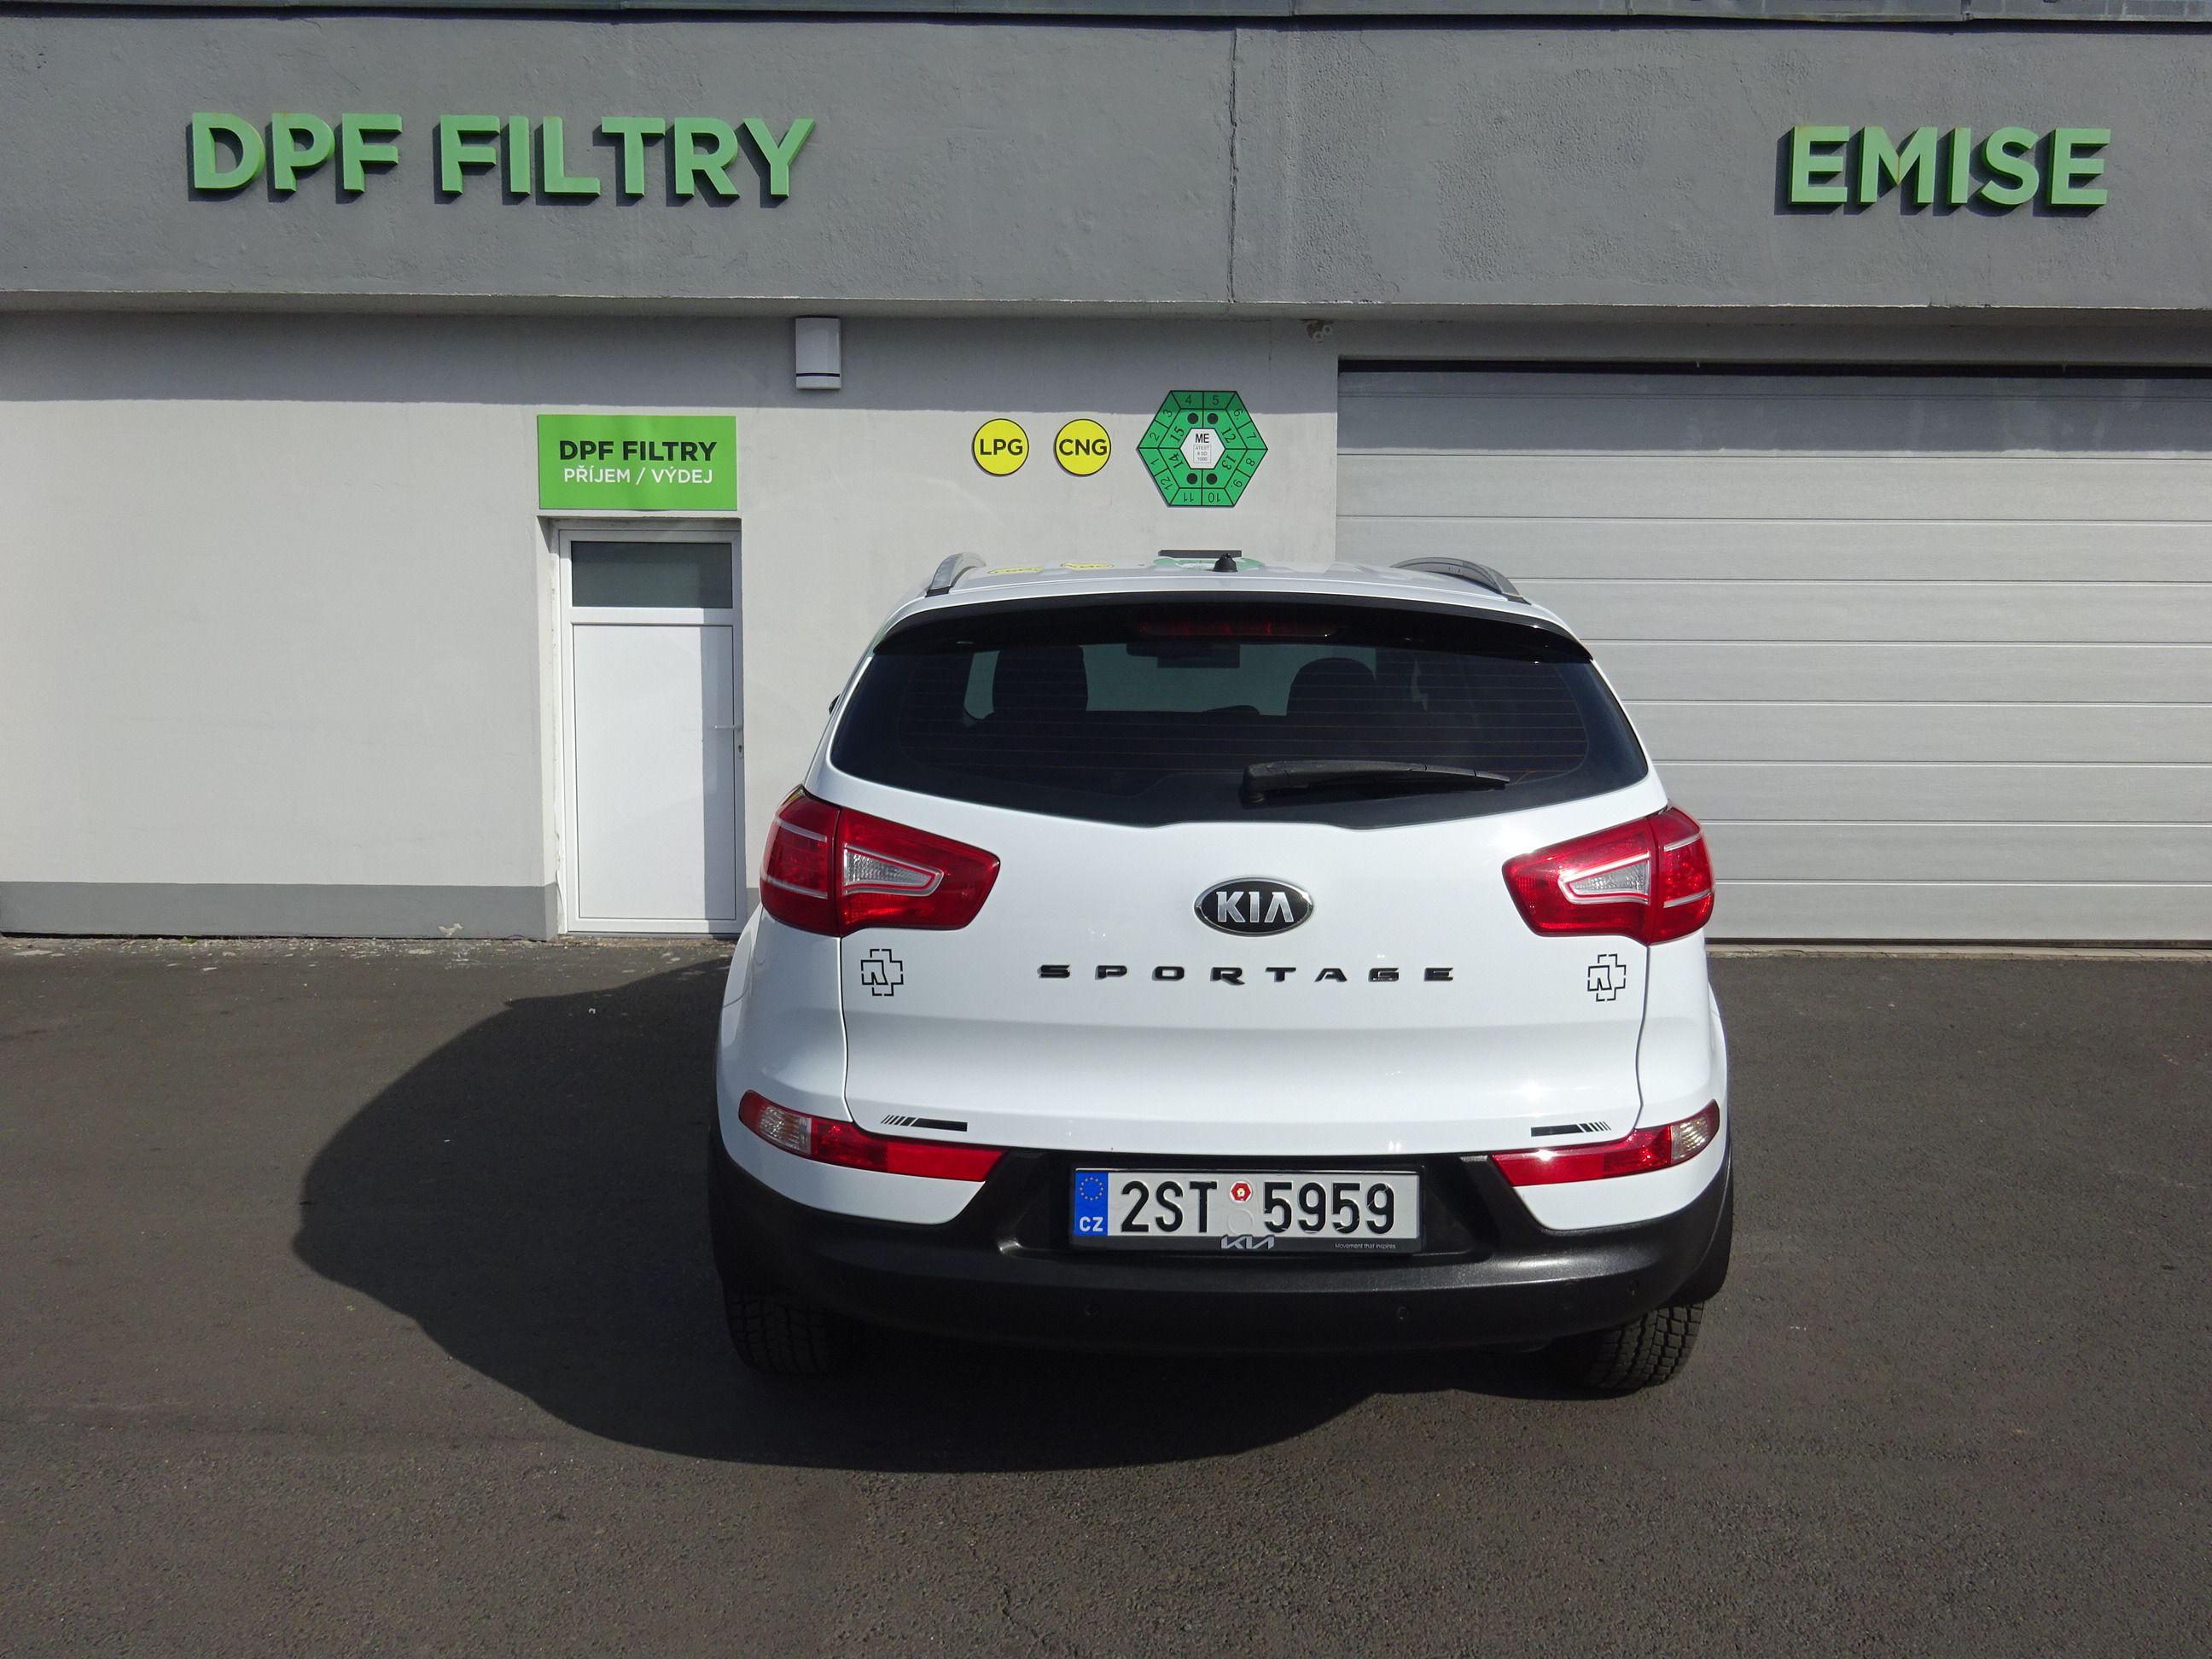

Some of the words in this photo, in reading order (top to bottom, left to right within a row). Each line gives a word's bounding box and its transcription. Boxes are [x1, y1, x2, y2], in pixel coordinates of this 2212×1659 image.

[191, 112, 403, 193] DPF
[439, 113, 816, 199] FILTRY
[1790, 125, 2111, 206] EMISE
[1185, 395, 1192, 405] 4
[1212, 395, 1220, 405] 5
[1162, 409, 1173, 418] 3
[1150, 432, 1160, 441] 2
[1169, 426, 1185, 443] 15
[1195, 434, 1209, 444] ME
[1221, 428, 1237, 443] 12
[559, 439, 614, 461] DPF
[622, 441, 718, 462] FILTRY
[979, 439, 1023, 456] LPG
[1058, 438, 1108, 456] CNG
[1168, 452, 1184, 469] 14
[1221, 454, 1237, 470] 13
[1245, 457, 1255, 466] 8
[563, 464, 631, 483] PŘÍJEM
[635, 468, 646, 486] /
[651, 466, 713, 484] VÝDEJ
[1160, 476, 1173, 491] 12
[1183, 492, 1194, 502] 11
[1208, 492, 1221, 503] 10
[1215, 890, 1295, 923] KIA
[1037, 963, 1455, 986] SPORTAGE
[1121, 1180, 1219, 1233] 2ST
[1264, 1181, 1396, 1235] 5959
[1079, 1217, 1104, 1232] CZ
